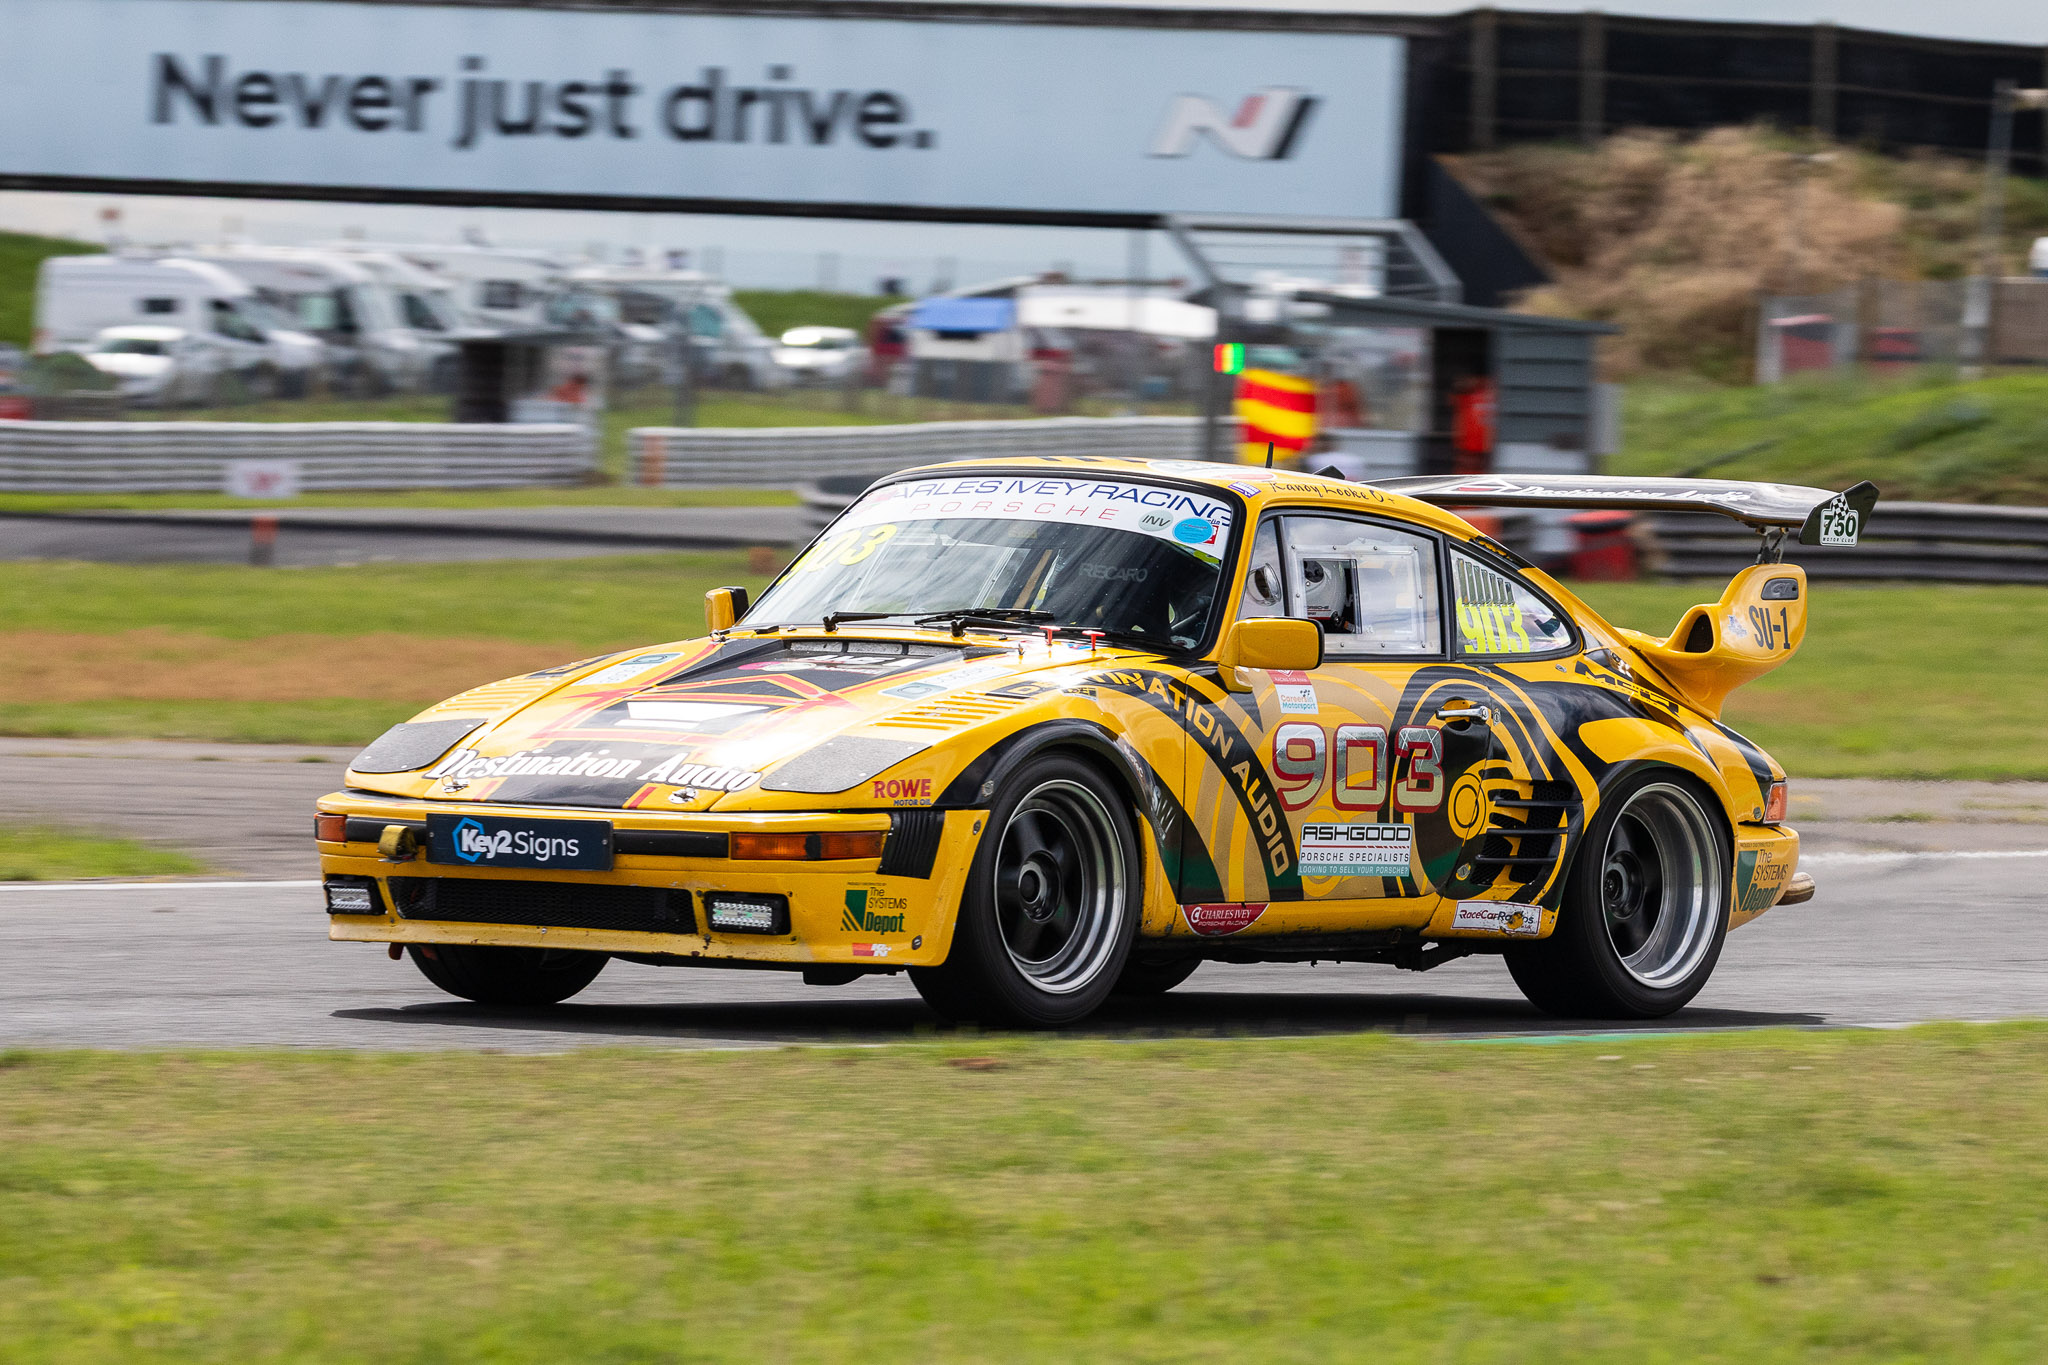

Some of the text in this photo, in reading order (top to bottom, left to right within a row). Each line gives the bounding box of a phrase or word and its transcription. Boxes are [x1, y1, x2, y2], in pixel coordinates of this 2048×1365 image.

[149, 52, 938, 151] Never just drive.
[908, 500, 1120, 521] PORSCHE
[1004, 480, 1089, 495] IVEY
[1090, 483, 1232, 527] RACING
[1140, 513, 1173, 529] INV
[1823, 514, 1857, 537] 750
[1079, 562, 1148, 584] RECARO
[1455, 598, 1531, 654] 903
[1748, 605, 1791, 651] SU-1
[1282, 702, 1316, 711] Motorsport
[425, 748, 763, 792] Destination Audio
[1272, 721, 1446, 814] 903
[872, 778, 932, 799] ROWE
[893, 799, 933, 807] MOTOR OIL
[1231, 760, 1290, 878] AUDIO
[1302, 825, 1412, 842] ASHGOOD
[461, 828, 580, 862] Key2Signs
[1300, 852, 1410, 863] PORSCHE SPECIALISTS
[1759, 849, 1773, 863] The
[1299, 865, 1409, 875] LOOKING TO SELL YOUR PORSCHE?
[1754, 864, 1788, 881] SYSTEMS
[869, 886, 885, 897] The
[1742, 881, 1781, 914] Depot
[868, 897, 908, 910] SYSTEMS
[864, 911, 905, 935] Depot
[1198, 919, 1227, 927] PORSCHE
[1200, 909, 1252, 920] CHARLES IVEY
